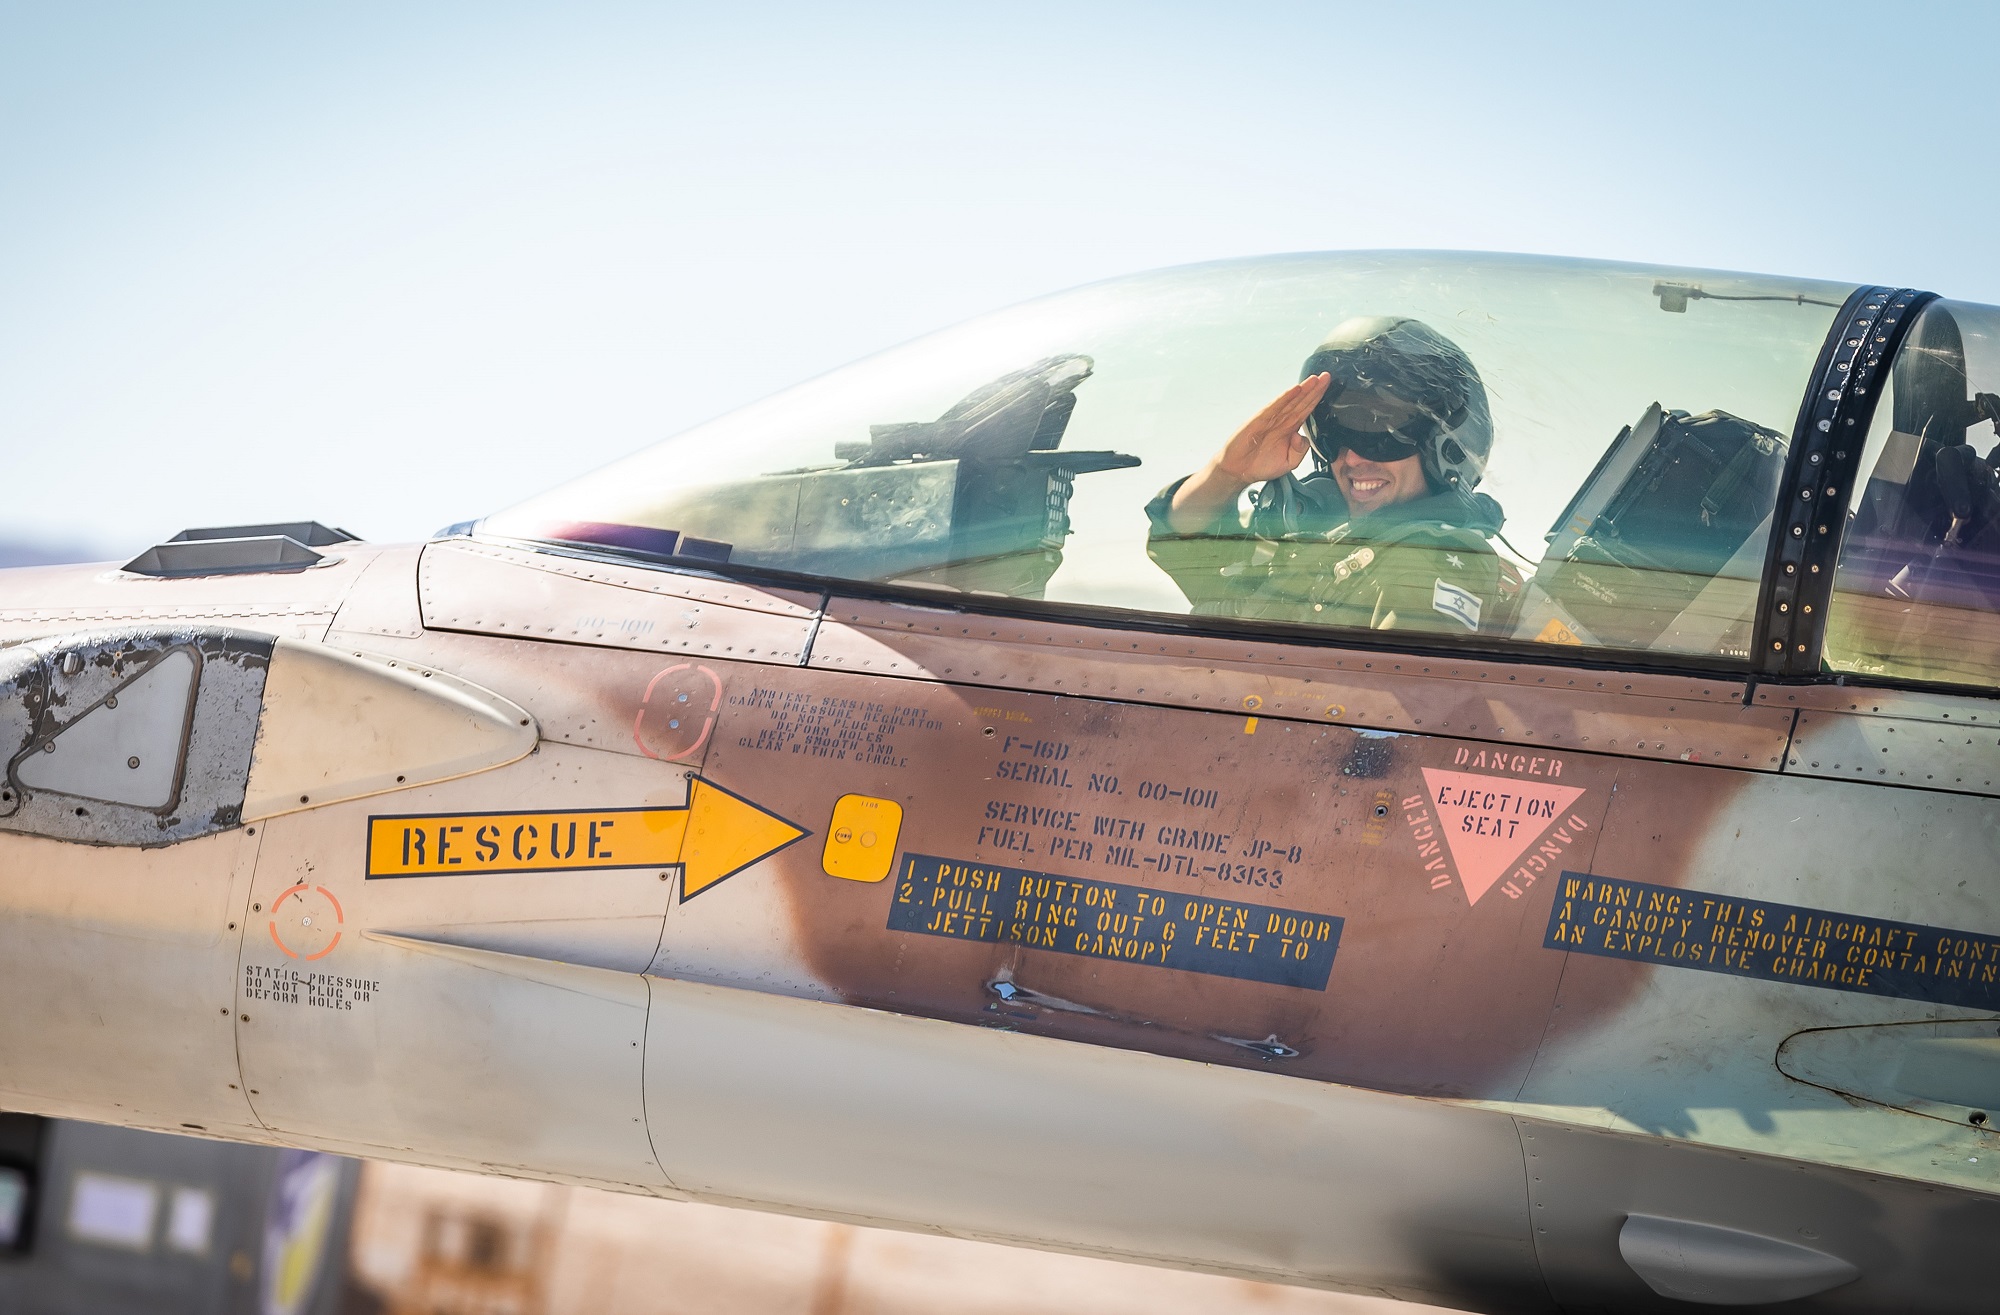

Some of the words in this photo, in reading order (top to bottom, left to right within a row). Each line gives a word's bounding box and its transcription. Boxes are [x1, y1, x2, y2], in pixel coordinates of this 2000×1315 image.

[729, 695, 774, 709] CABIN
[783, 701, 852, 719] PRESSURE
[864, 712, 943, 731] REGULATOR
[750, 688, 812, 704] AMBIENT
[822, 697, 884, 713] SENSING
[894, 706, 928, 718] PORT
[771, 710, 788, 720] DO
[797, 713, 824, 725] NOT
[833, 719, 868, 731] PLUG
[878, 724, 895, 735] OR
[776, 721, 830, 736] DEFORM
[838, 729, 884, 743] HOLES
[739, 737, 783, 751] CLEAN
[792, 744, 846, 760] WITHIN
[855, 753, 908, 768] CIRCLE
[759, 729, 795, 742] KEEP
[805, 735, 858, 750] SMOOTH
[867, 743, 893, 755] AND
[1002, 736, 1070, 761] F-16D
[1454, 747, 1563, 777] DANGER
[996, 761, 1073, 788] SERIAL
[1088, 774, 1123, 795] NO.
[1138, 780, 1219, 809] 00-1011
[1437, 786, 1556, 818] EJECTION
[402, 820, 615, 866] RESCUE
[985, 801, 1081, 832] SERVICE
[1093, 815, 1146, 841] WITH
[1158, 825, 1231, 854] GRADE
[1243, 839, 1302, 864] JP-8
[1402, 794, 1452, 890] DANGER
[1461, 815, 1520, 839] SEAT
[977, 827, 1035, 853] FUEL
[1050, 835, 1093, 861] PER
[1105, 845, 1284, 889] MIL-DTL-83133
[1500, 814, 1588, 899] DANGER
[1019, 876, 1117, 909] BUTTON
[1137, 893, 1166, 915] TO
[1184, 901, 1250, 930] OPEN
[1267, 914, 1331, 942] DOOR
[927, 911, 1057, 948] JETTISON
[1075, 932, 1173, 964] CANOPY
[1015, 901, 1077, 927] RING
[1097, 911, 1145, 935] OUT
[1162, 922, 1176, 941] 6
[1194, 925, 1261, 954] FEET
[1280, 938, 1310, 960] TO
[1558, 901, 1573, 922] A
[1593, 906, 1693, 939] CANOPY
[1711, 922, 1828, 960] REMOVER
[1846, 945, 2000, 983] CONTAININ
[1784, 913, 1918, 950] AIRCRAFT
[1553, 922, 1586, 945] AN
[1604, 930, 1753, 970] EXPLOSIVE
[1772, 949, 1873, 987] CHARGE
[246, 965, 299, 981] STATIC
[309, 973, 380, 992] PRESSURE
[246, 976, 263, 988] DO
[272, 980, 299, 993] NOT
[308, 985, 343, 999] PLUG
[354, 990, 370, 1002] OR
[246, 988, 298, 1004] DEFORM
[308, 995, 353, 1011] HOLES
